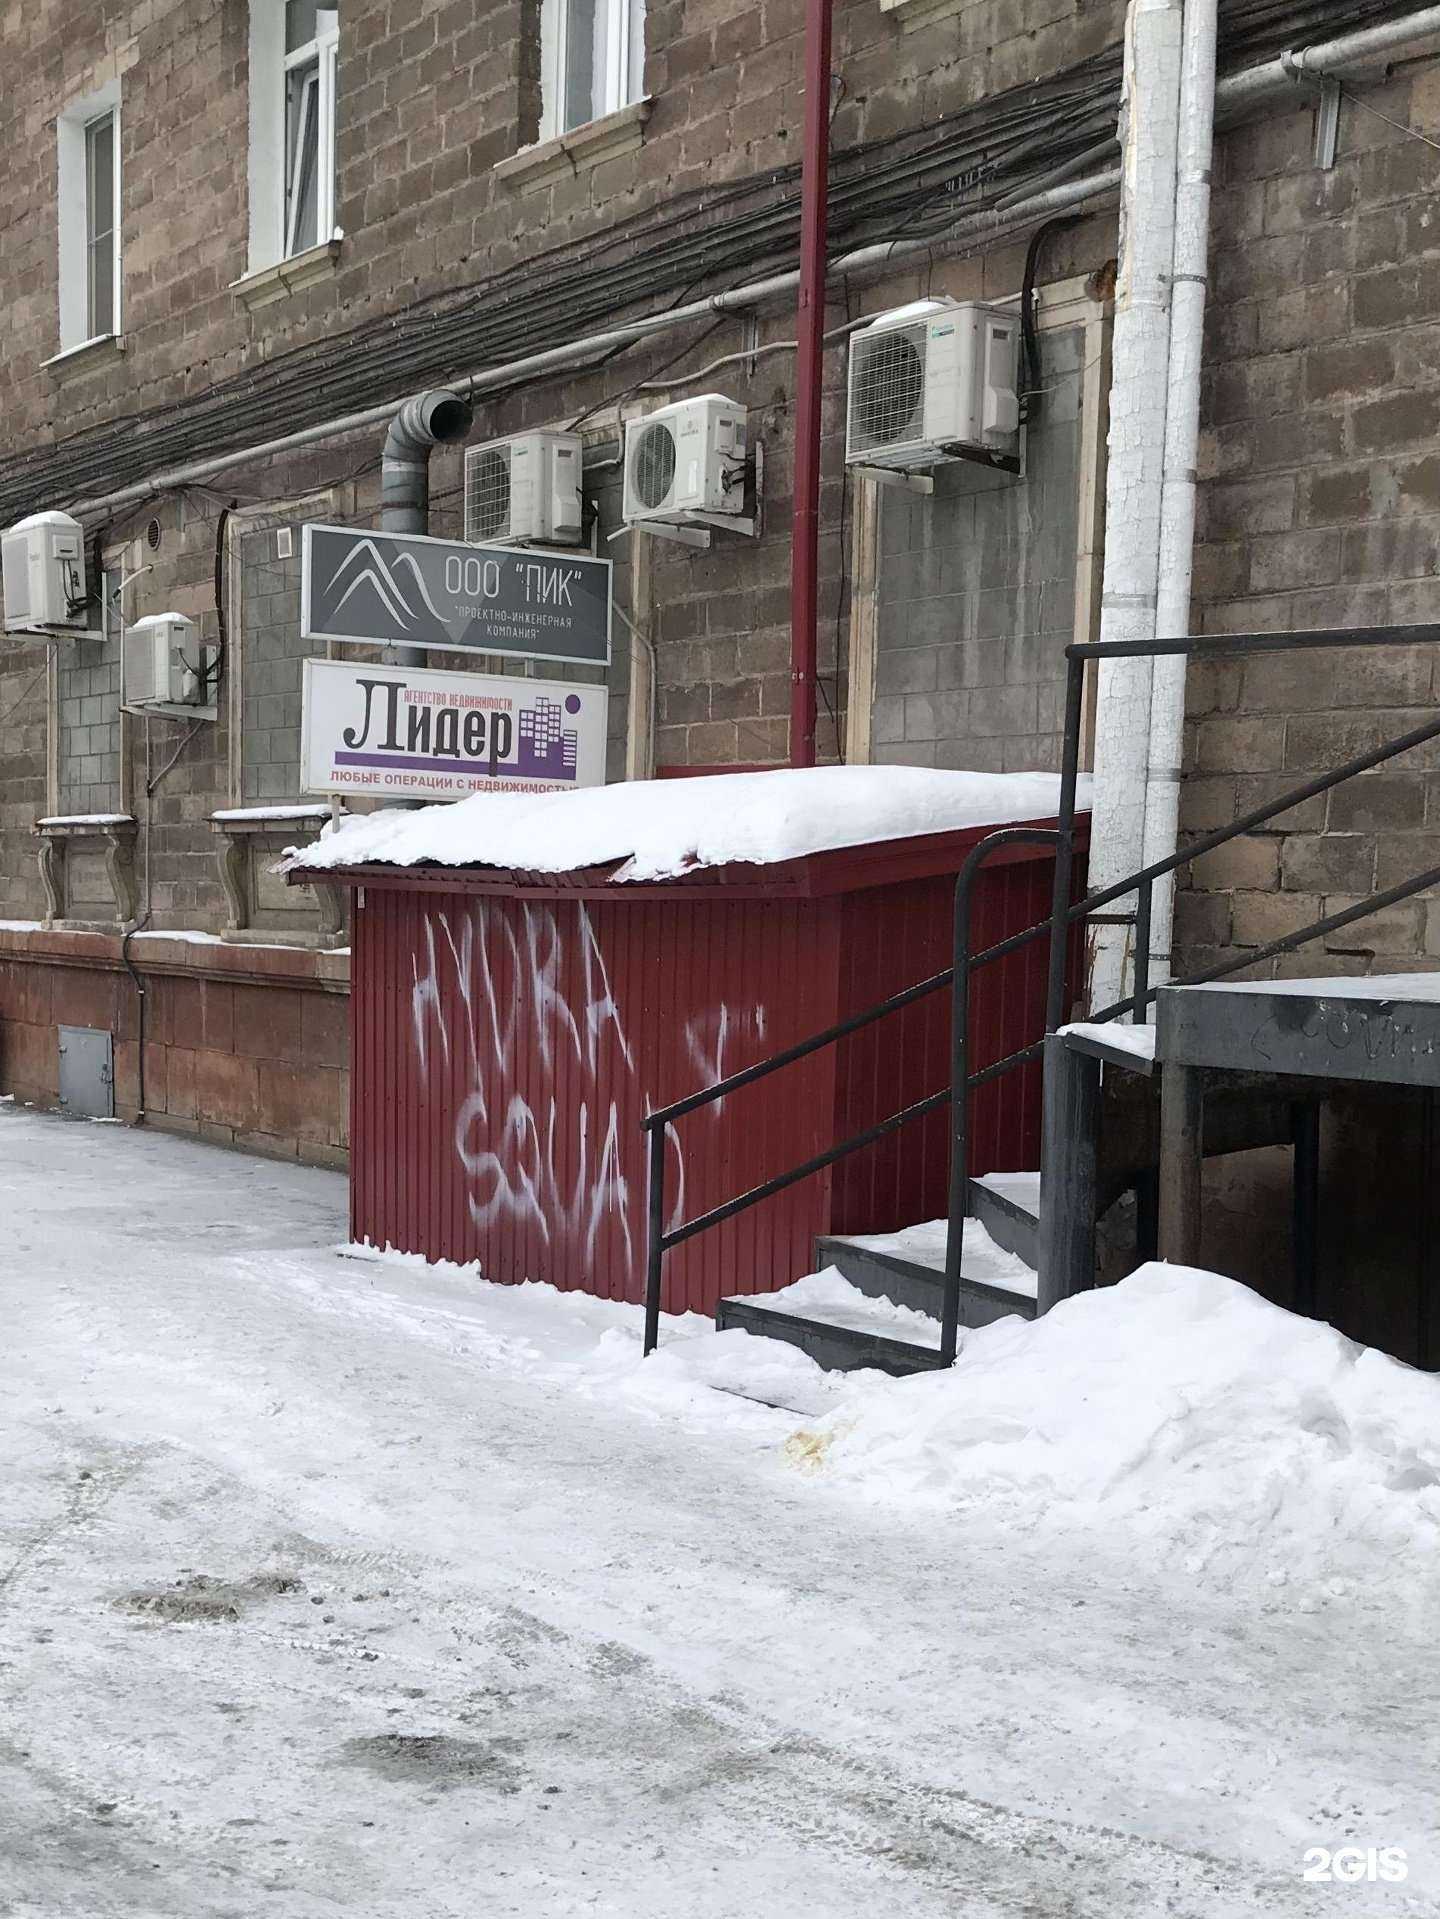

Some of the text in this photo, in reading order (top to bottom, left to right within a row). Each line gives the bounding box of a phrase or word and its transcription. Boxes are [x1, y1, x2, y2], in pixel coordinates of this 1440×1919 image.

[445, 555, 500, 598] ООО
[403, 689, 513, 711] АГЕНТСТВО НЕДВИЖИМОСТИ
[343, 678, 513, 778] Лидер
[331, 770, 381, 785] ЛЮБЫЕ
[384, 773, 453, 790] ОПЕРАЦИИ
[456, 778, 465, 790] С
